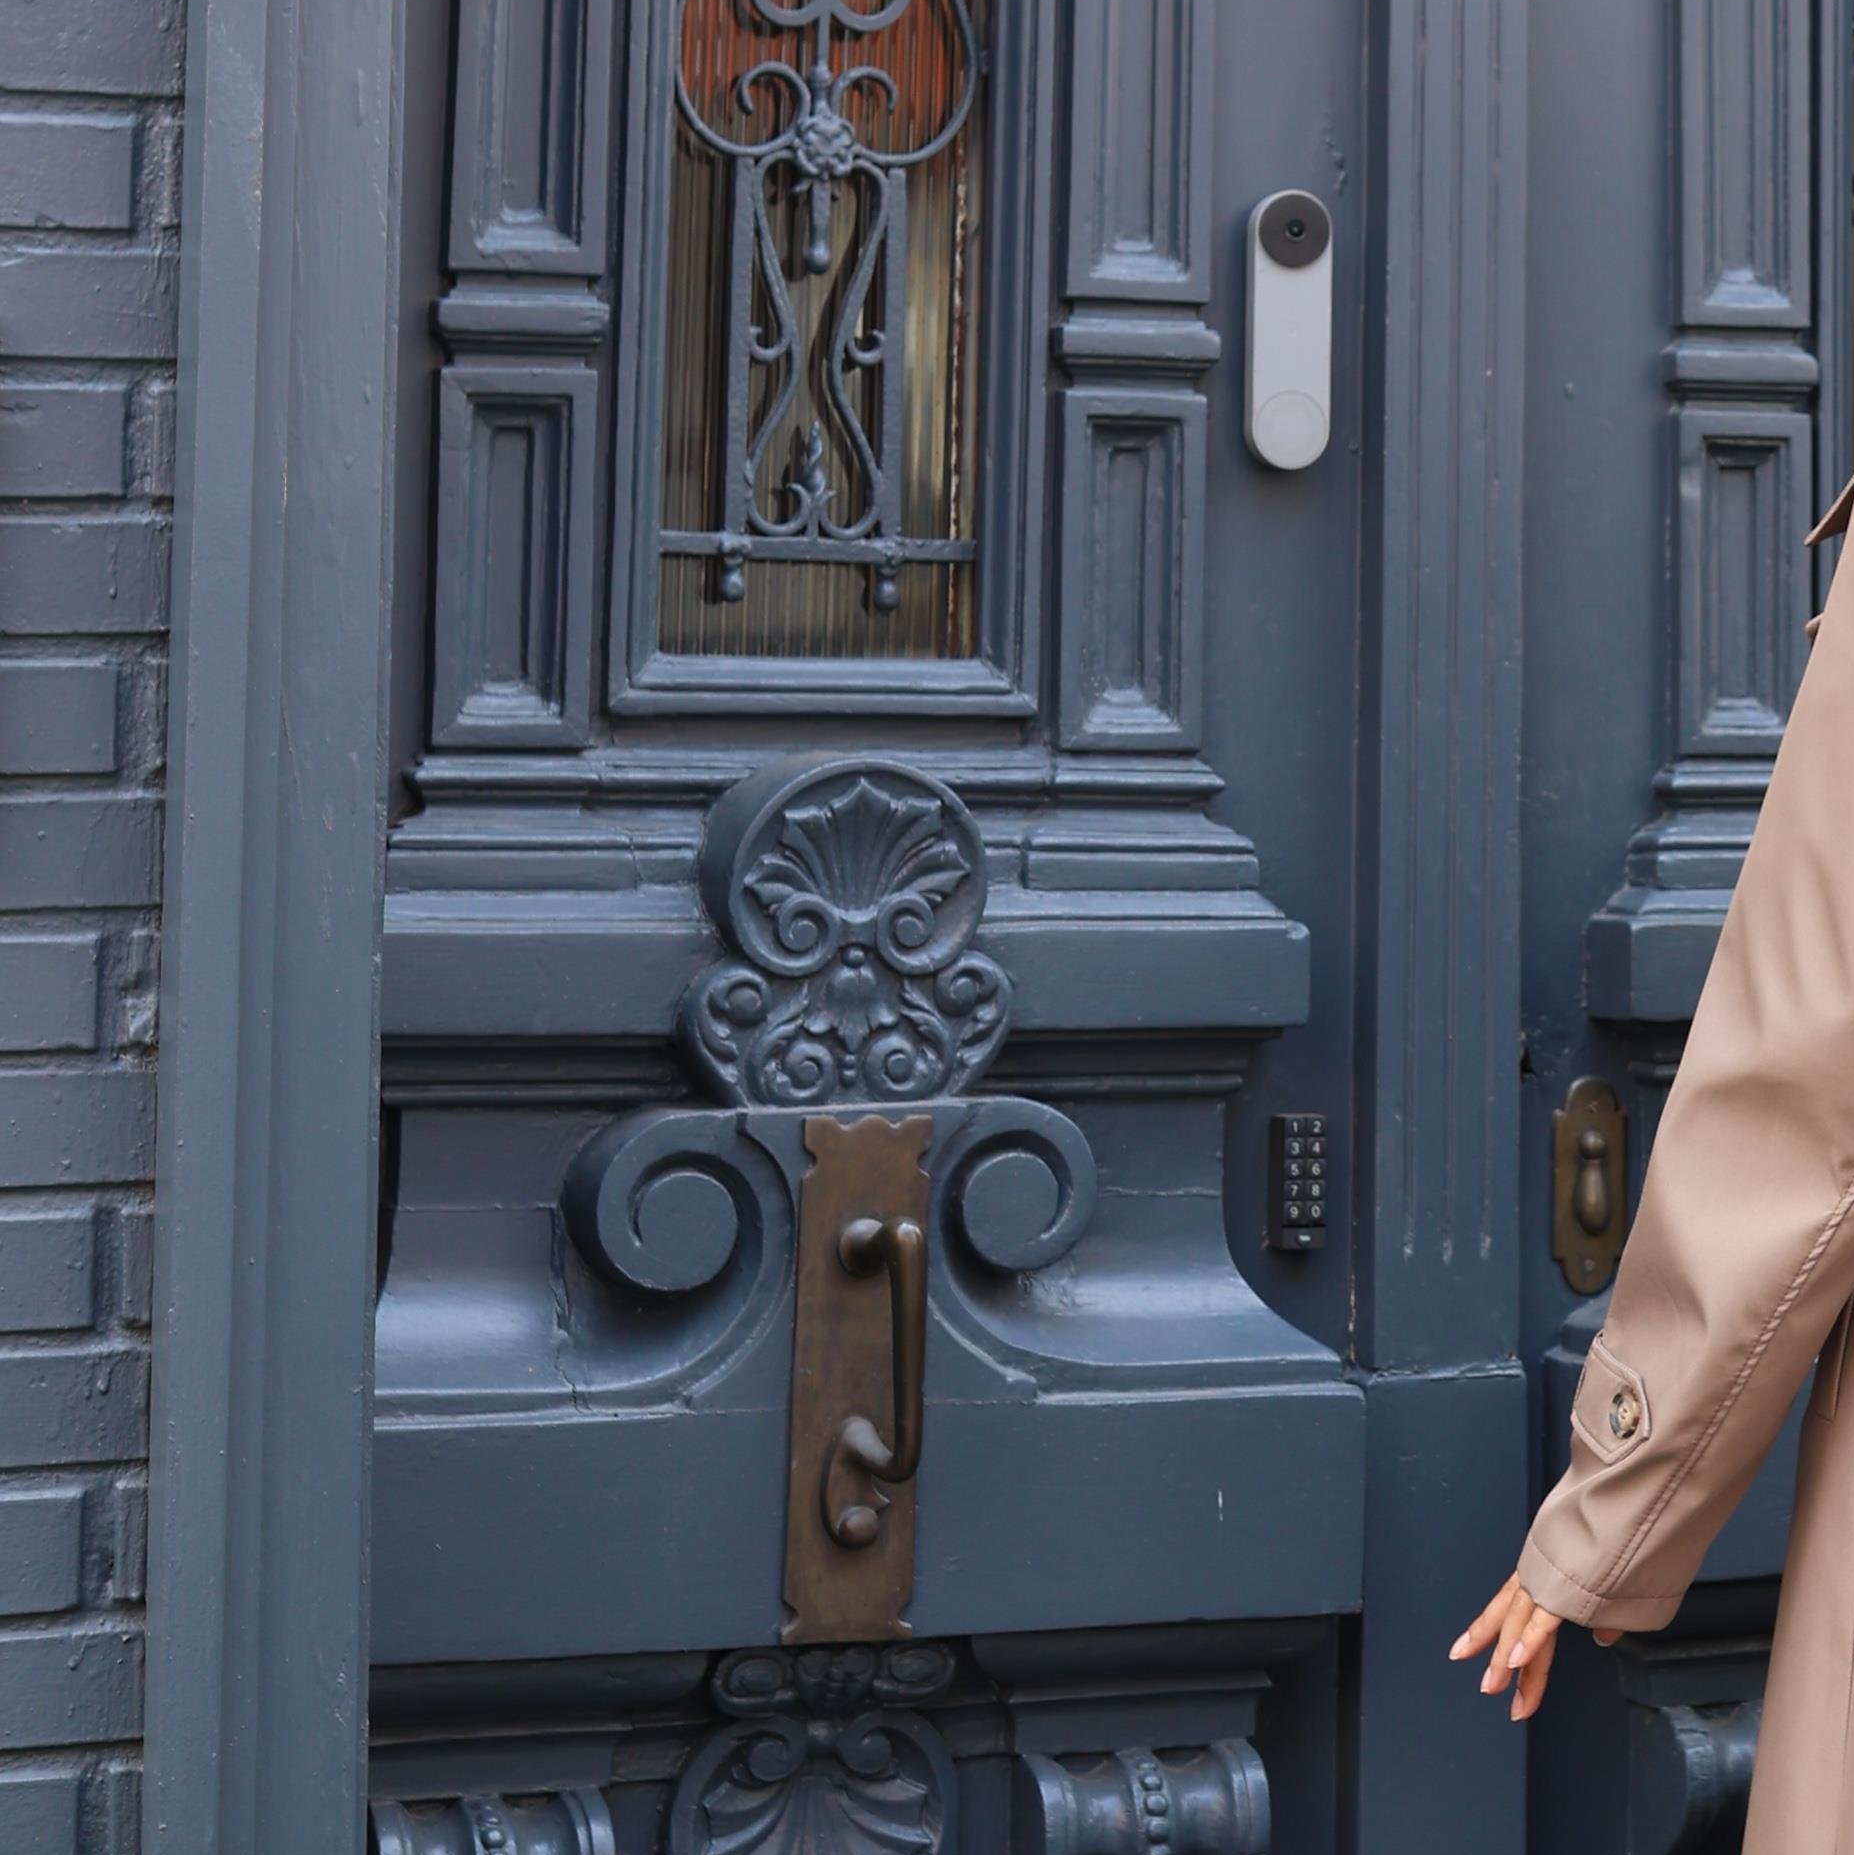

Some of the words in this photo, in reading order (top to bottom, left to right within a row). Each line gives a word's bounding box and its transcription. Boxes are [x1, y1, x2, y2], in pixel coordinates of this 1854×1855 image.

[1312, 1120, 1321, 1133] 2
[1290, 1141, 1300, 1155] 3
[1311, 1141, 1320, 1153] 4
[1290, 1163, 1300, 1176] 5
[1311, 1162, 1321, 1175] 6
[1290, 1184, 1298, 1196] 7
[1311, 1183, 1320, 1196] 8
[1289, 1206, 1299, 1218] 9
[1311, 1205, 1320, 1218] 0
